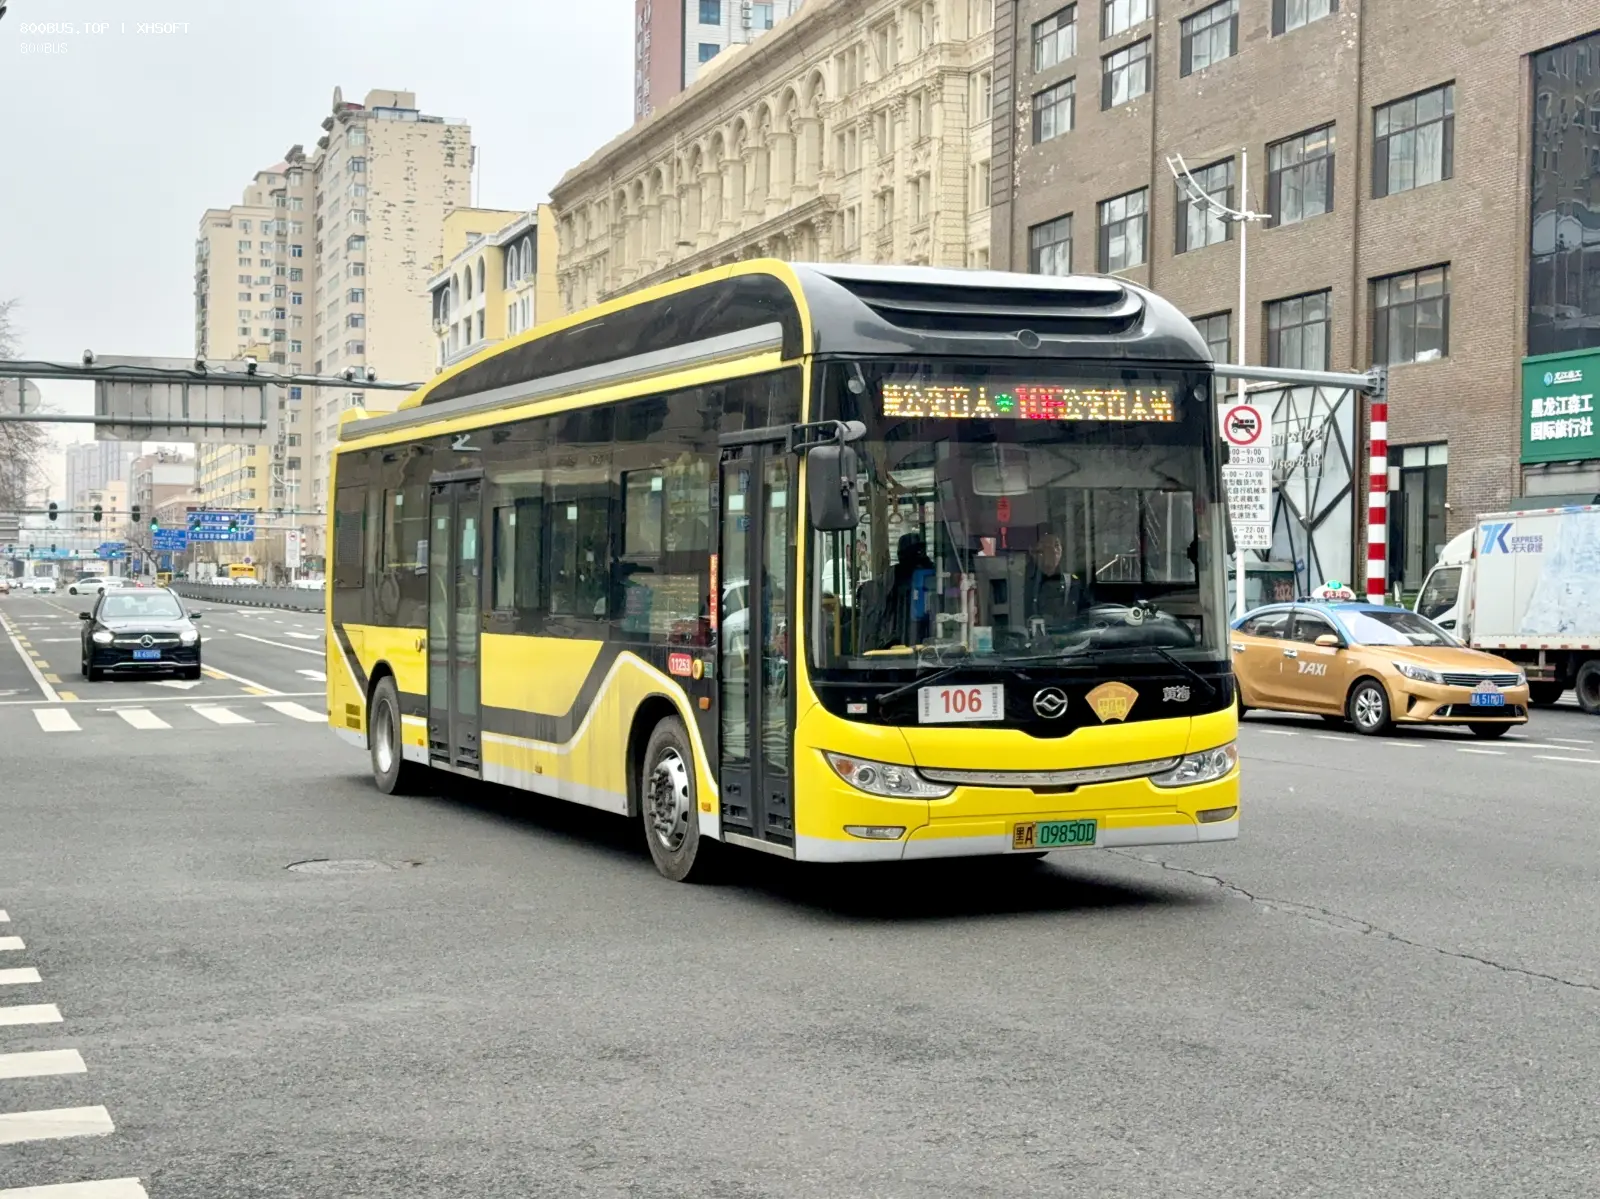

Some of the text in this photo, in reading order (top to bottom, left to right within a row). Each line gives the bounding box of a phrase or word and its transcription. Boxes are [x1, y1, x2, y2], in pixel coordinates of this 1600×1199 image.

[1530, 416, 1594, 441] 国际旅行社
[1511, 535, 1543, 543] EXPRESS
[1298, 661, 1328, 676] TAXI
[941, 688, 982, 713] 106
